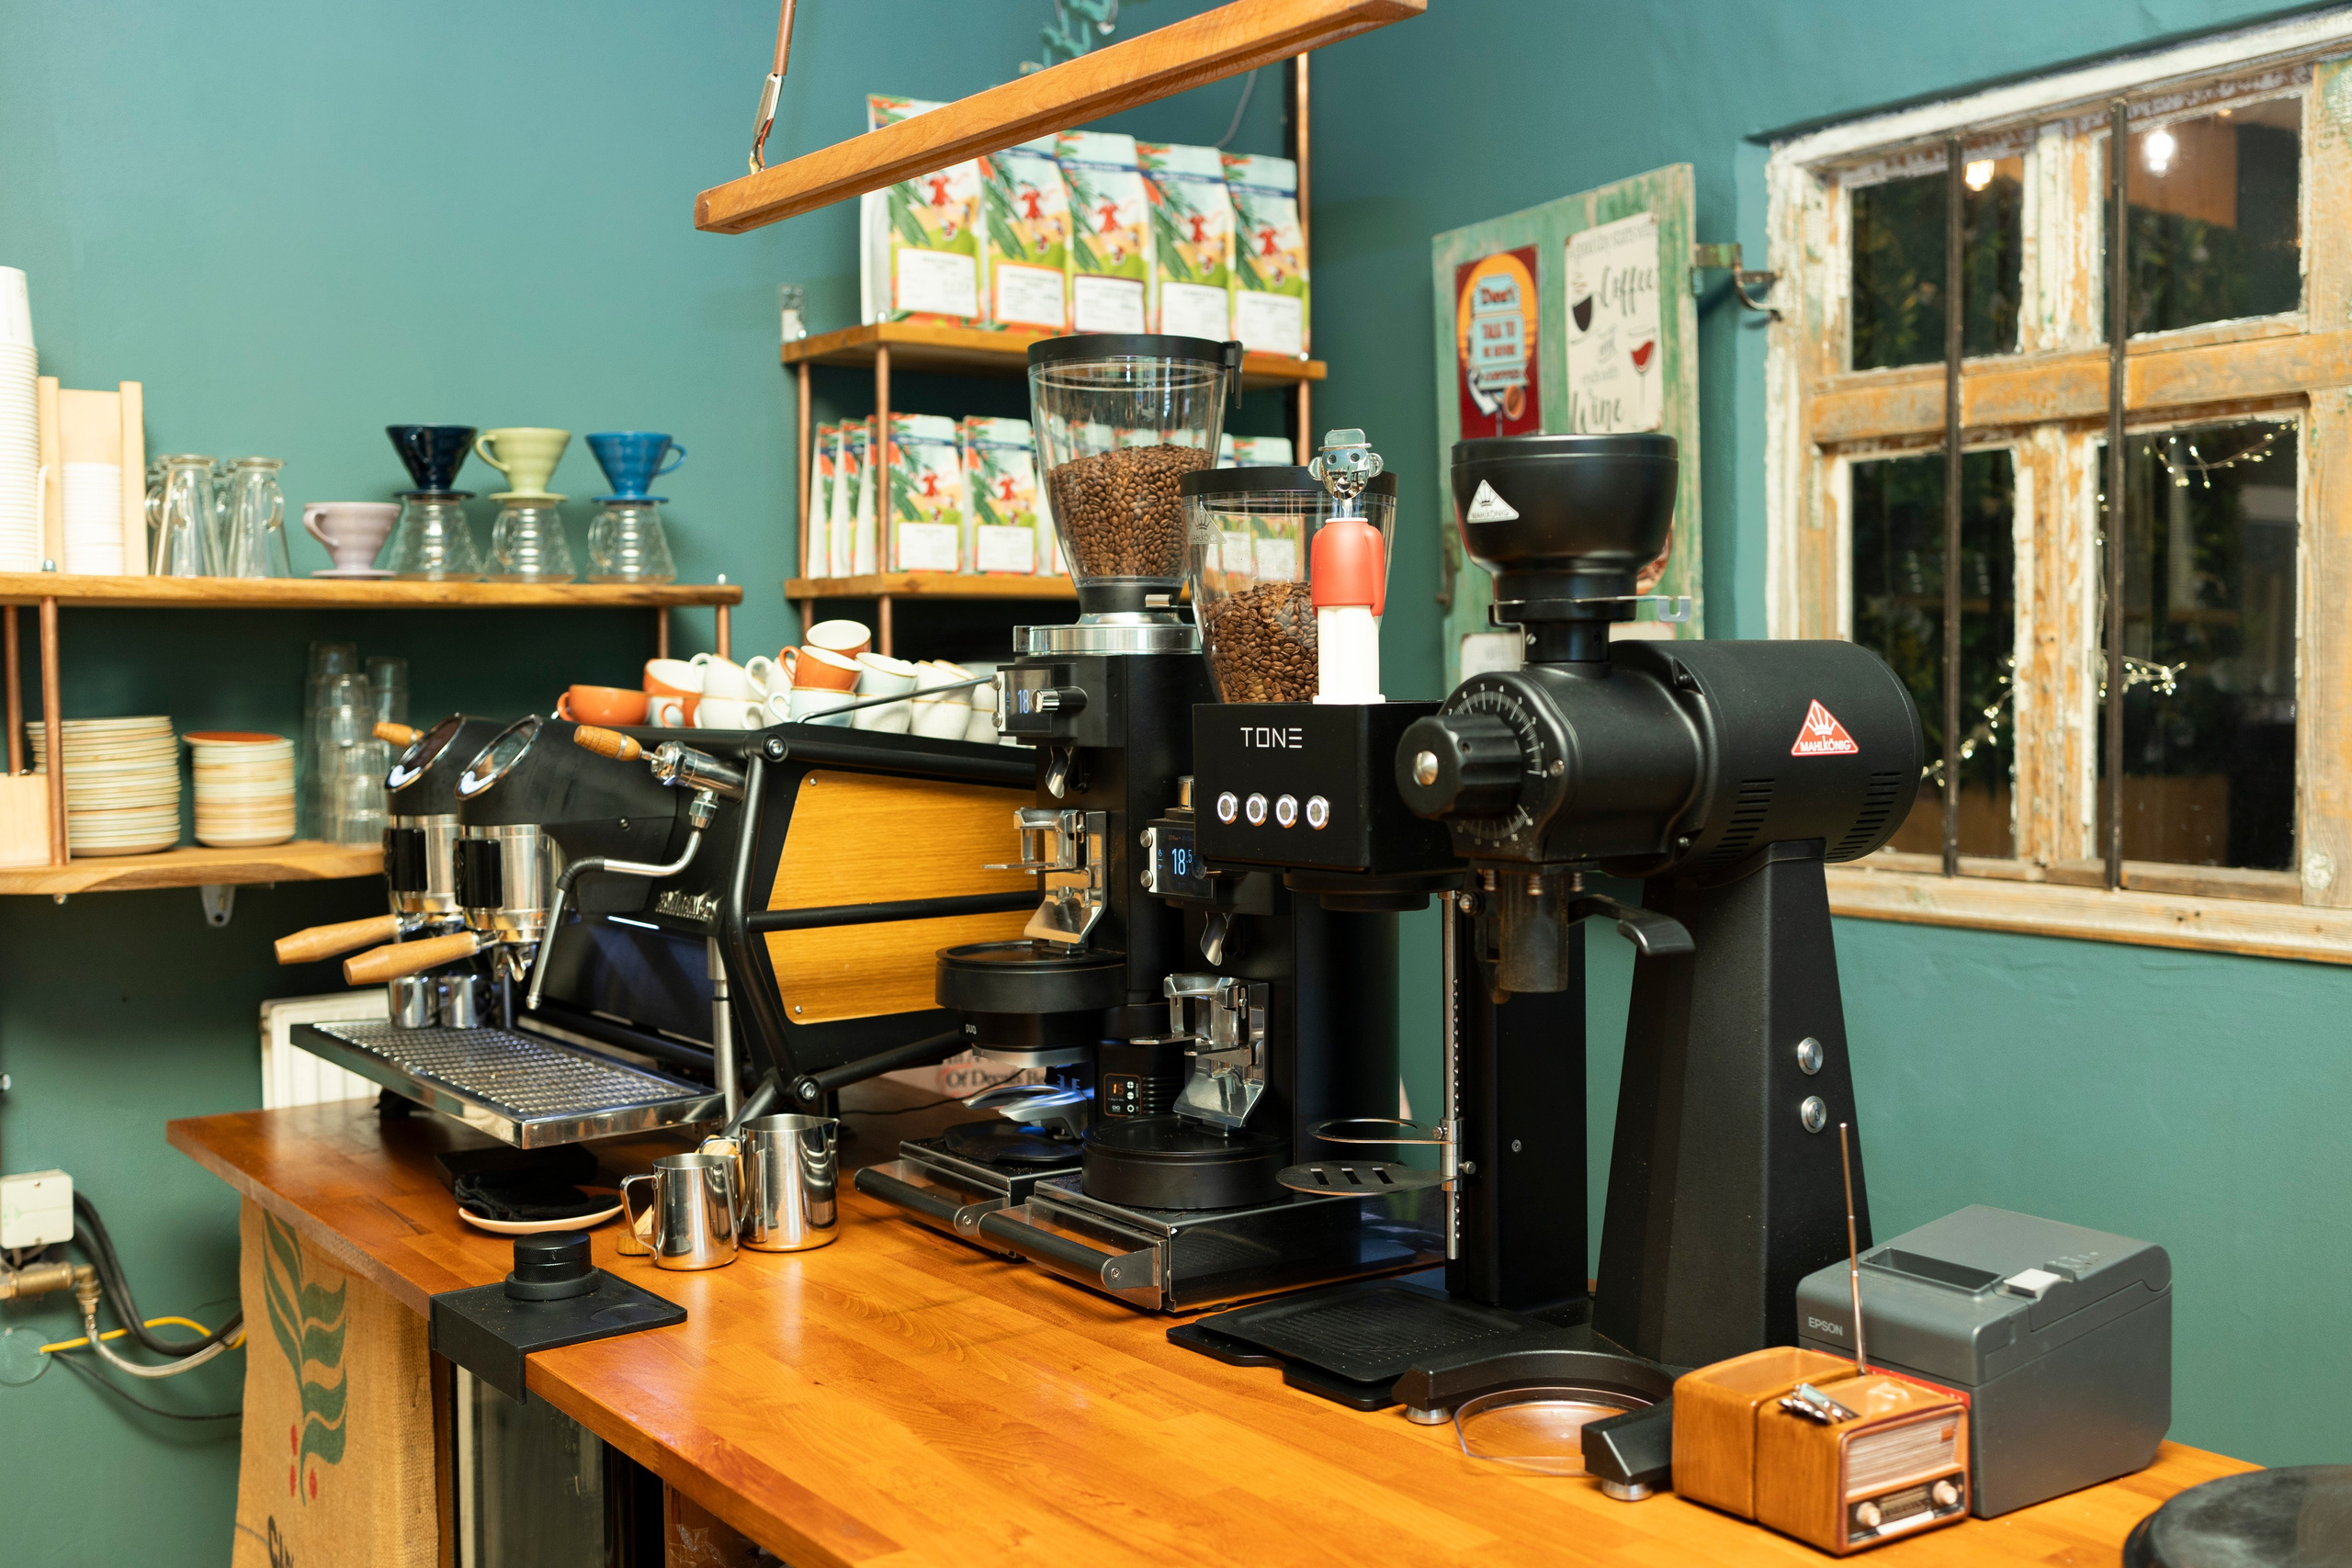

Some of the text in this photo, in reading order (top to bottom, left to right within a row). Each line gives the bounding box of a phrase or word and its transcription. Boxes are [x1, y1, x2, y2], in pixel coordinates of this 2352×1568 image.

[1600, 265, 1653, 317] Coffee
[1240, 728, 1302, 748] TONE
[1800, 737, 1851, 752] MAHLKÖNIG
[1808, 1316, 1843, 1337] EPSON
